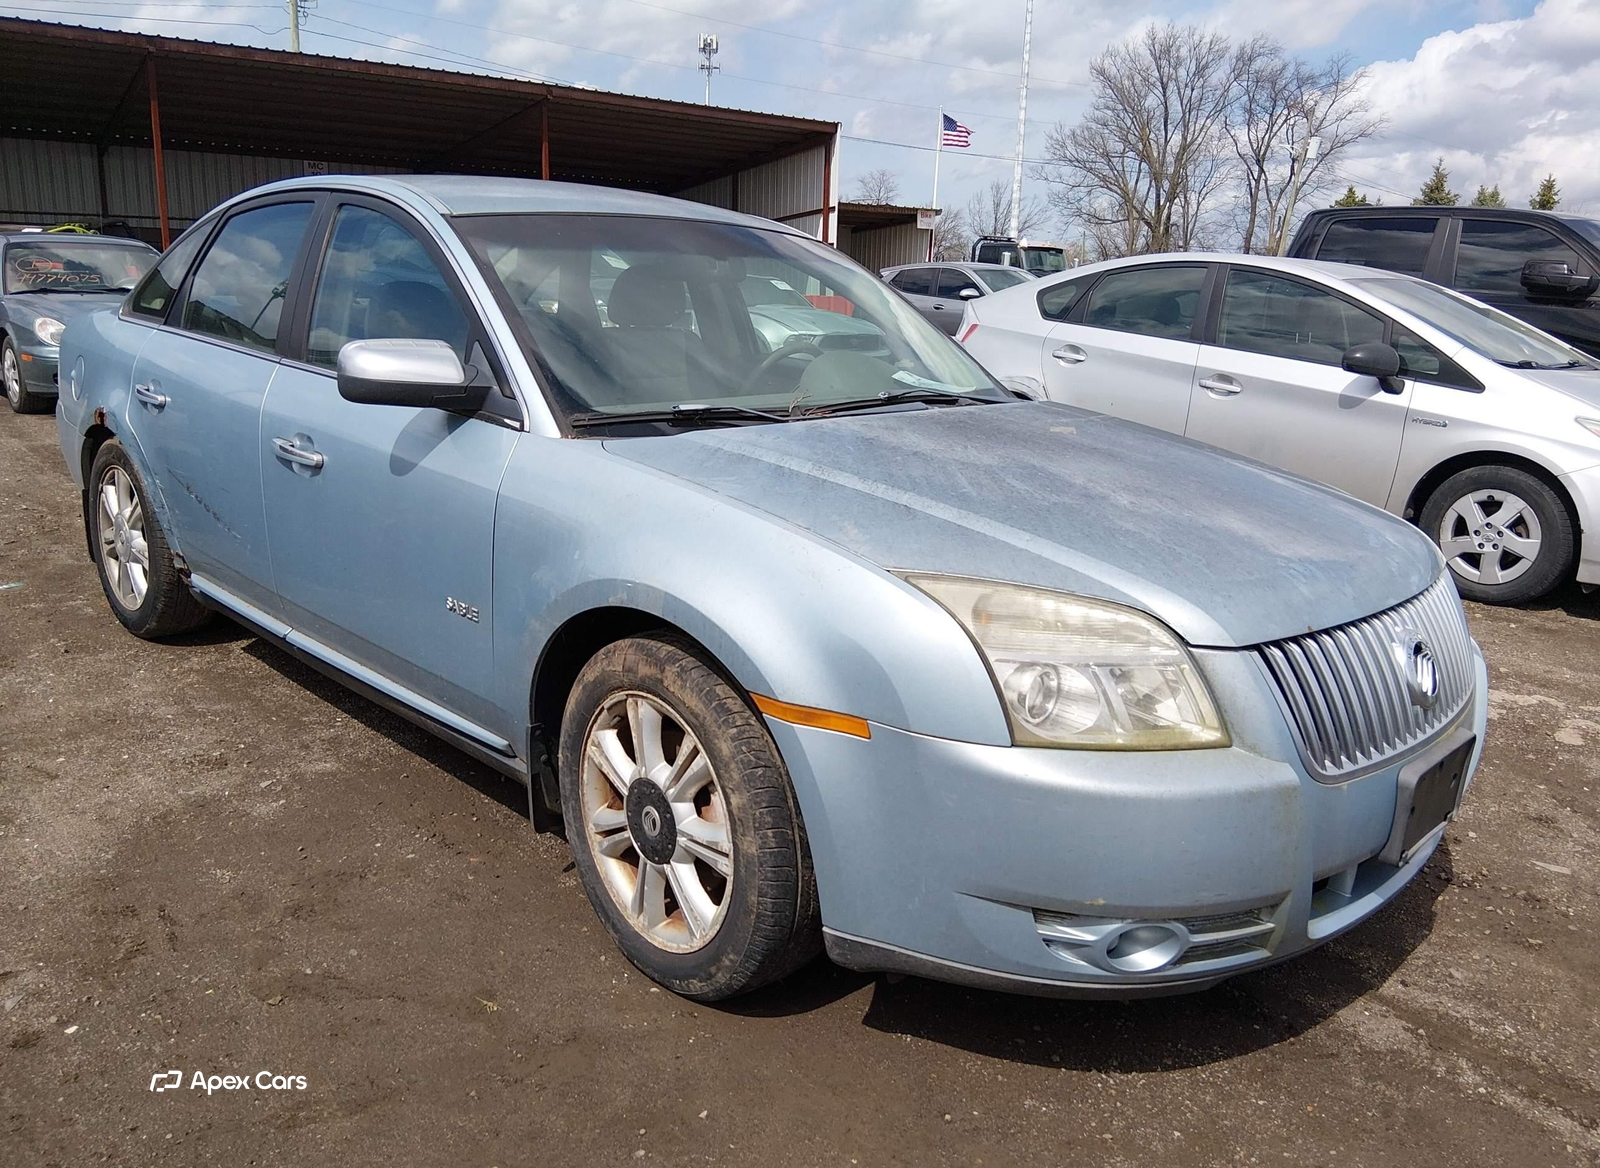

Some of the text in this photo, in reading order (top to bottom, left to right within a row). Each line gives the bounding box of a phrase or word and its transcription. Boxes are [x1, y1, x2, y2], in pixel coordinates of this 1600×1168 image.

[308, 162, 324, 170] MC
[1411, 417, 1442, 428] HYBRID
[446, 596, 480, 624] SABLE
